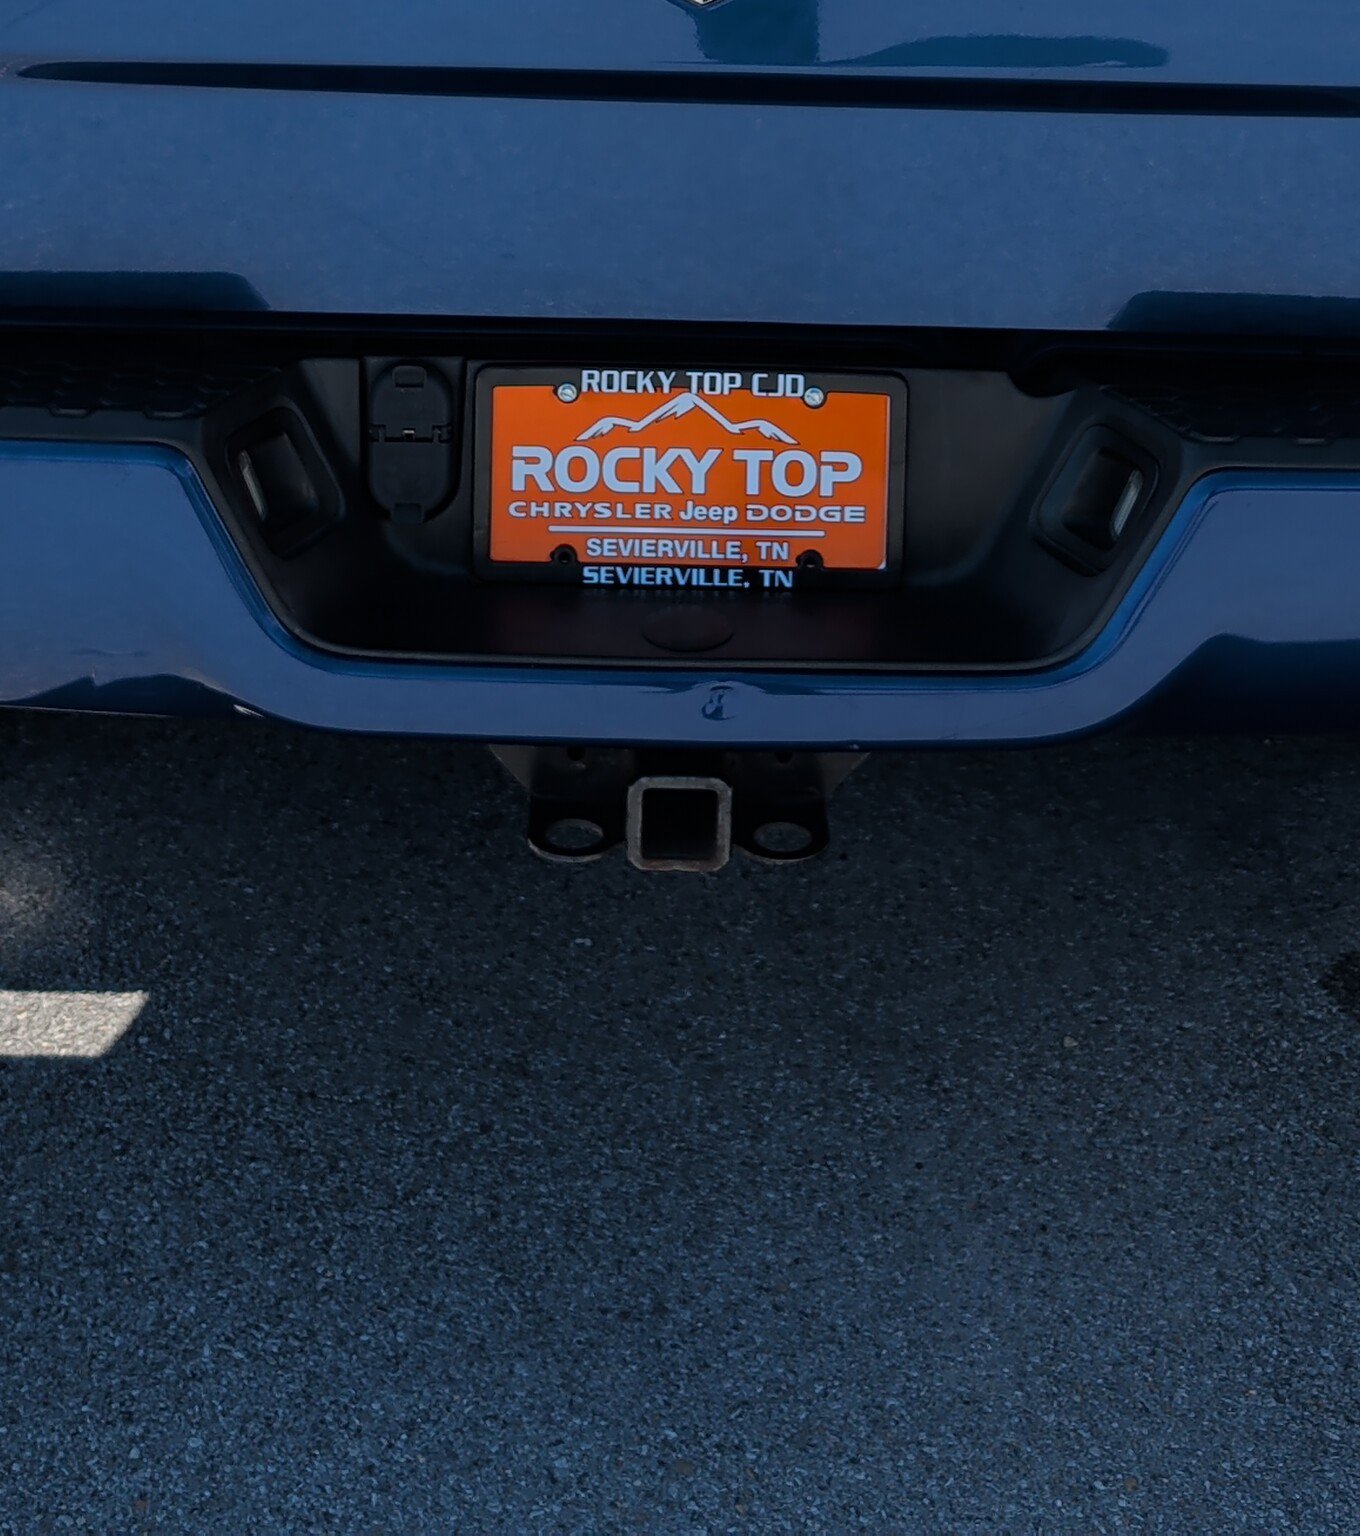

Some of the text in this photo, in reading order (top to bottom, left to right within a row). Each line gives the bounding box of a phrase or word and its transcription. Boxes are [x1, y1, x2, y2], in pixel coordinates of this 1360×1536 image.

[580, 369, 805, 398] ROCKY TOP CJD
[511, 445, 863, 497] ROCKY TOP
[508, 500, 865, 524] CHRYSLER Jeep DODGE
[586, 538, 789, 563] SEVIERVILLE, TN
[760, 569, 794, 589] TN
